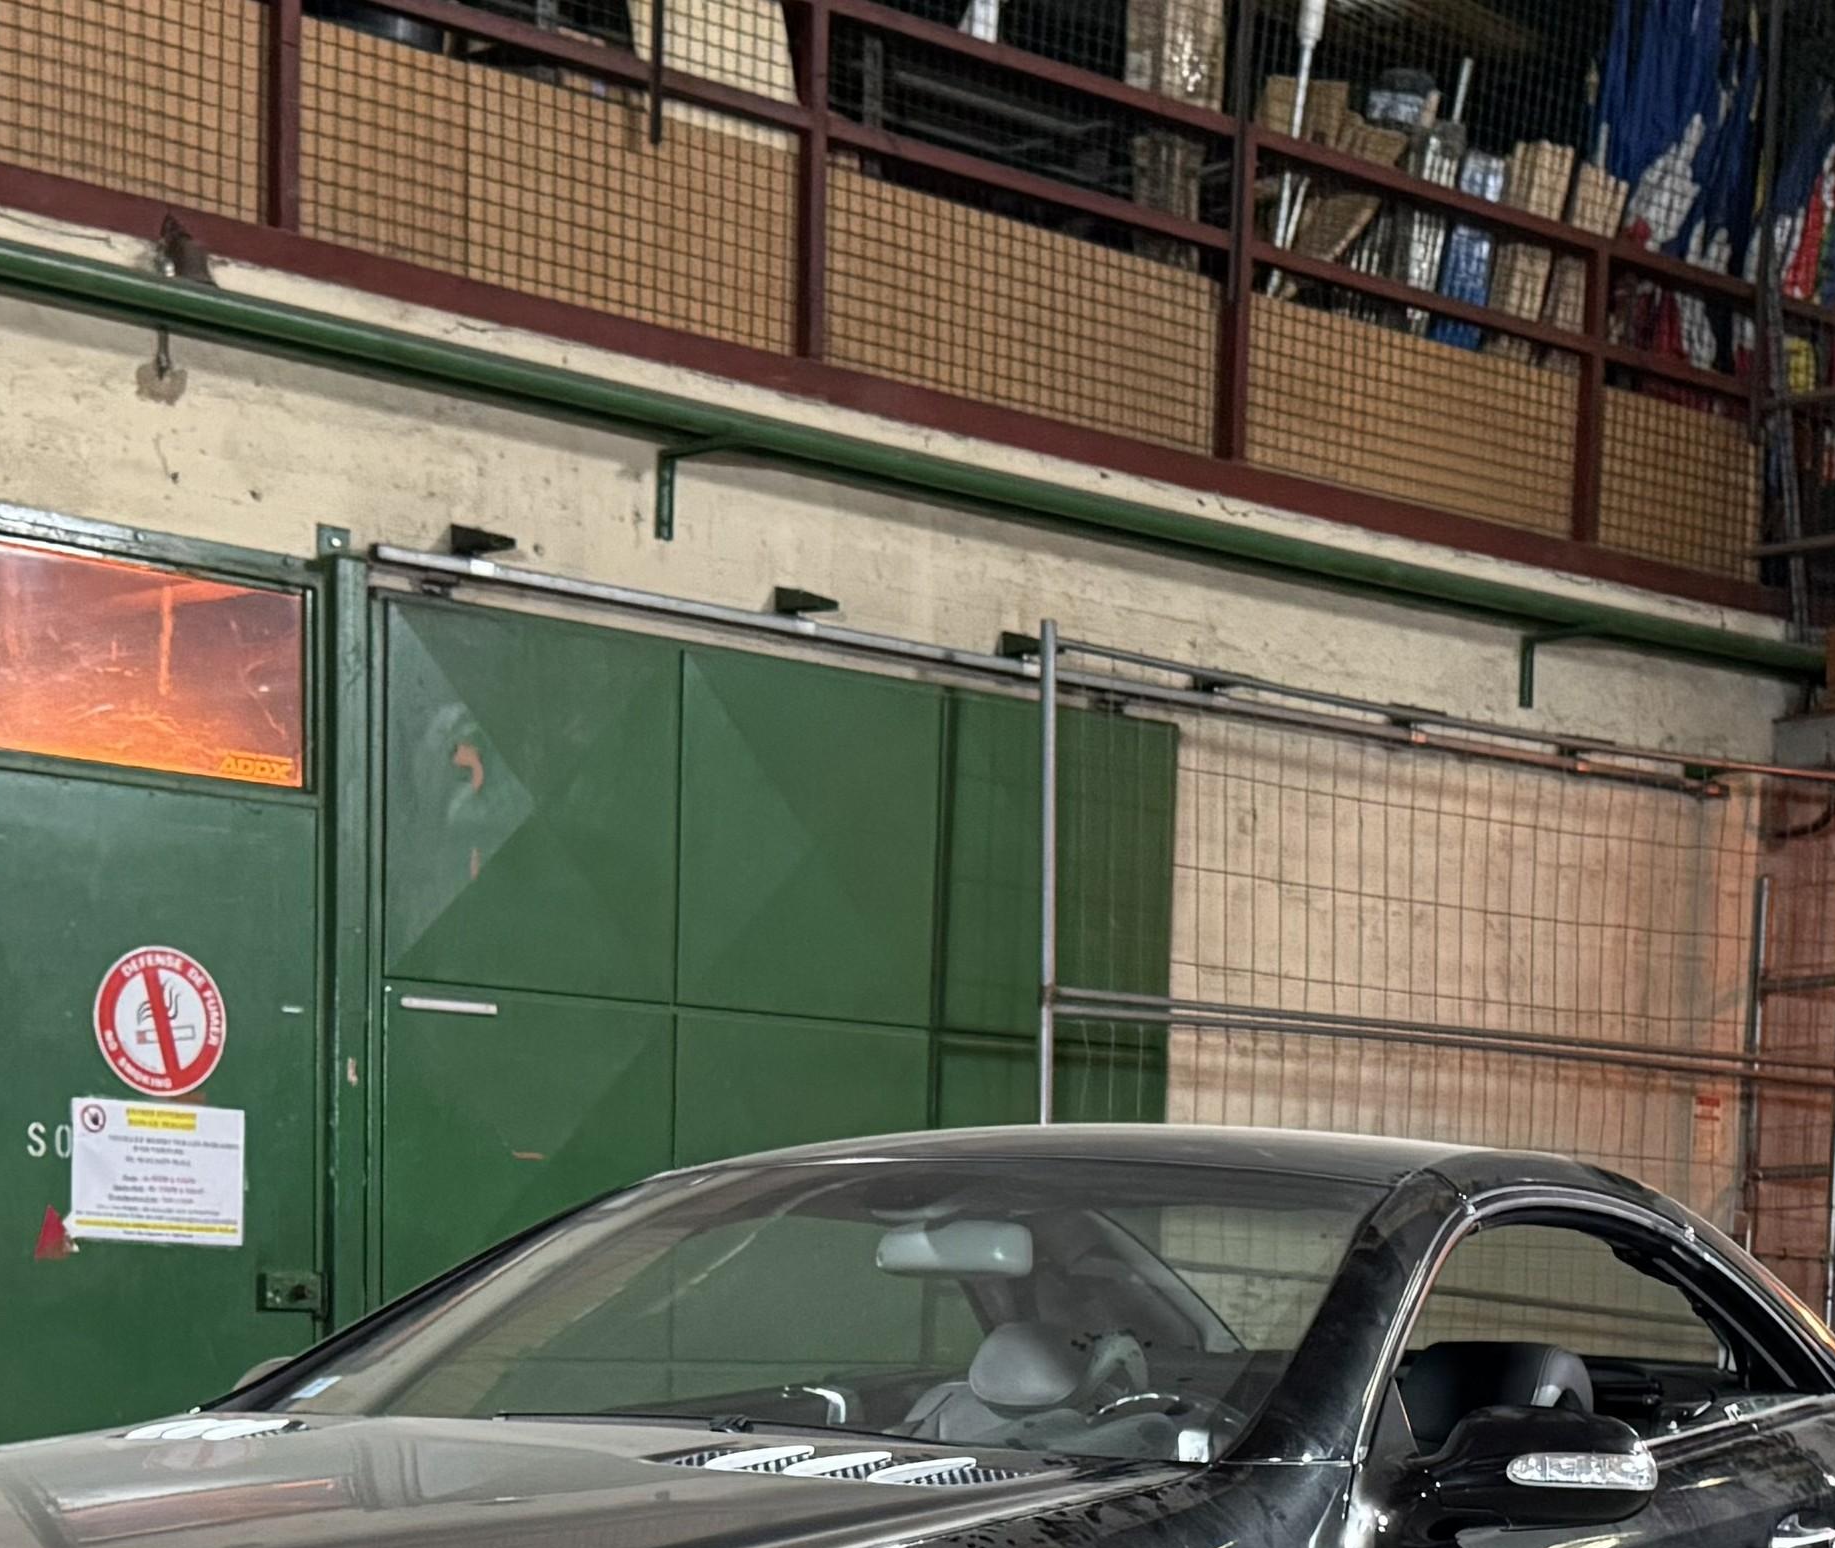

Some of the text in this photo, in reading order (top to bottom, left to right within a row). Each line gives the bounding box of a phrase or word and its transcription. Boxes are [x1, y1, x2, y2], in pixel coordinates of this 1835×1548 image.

[121, 954, 222, 1046] DEFENSE DE FUMER
[104, 1030, 172, 1089] NO SMOKING
